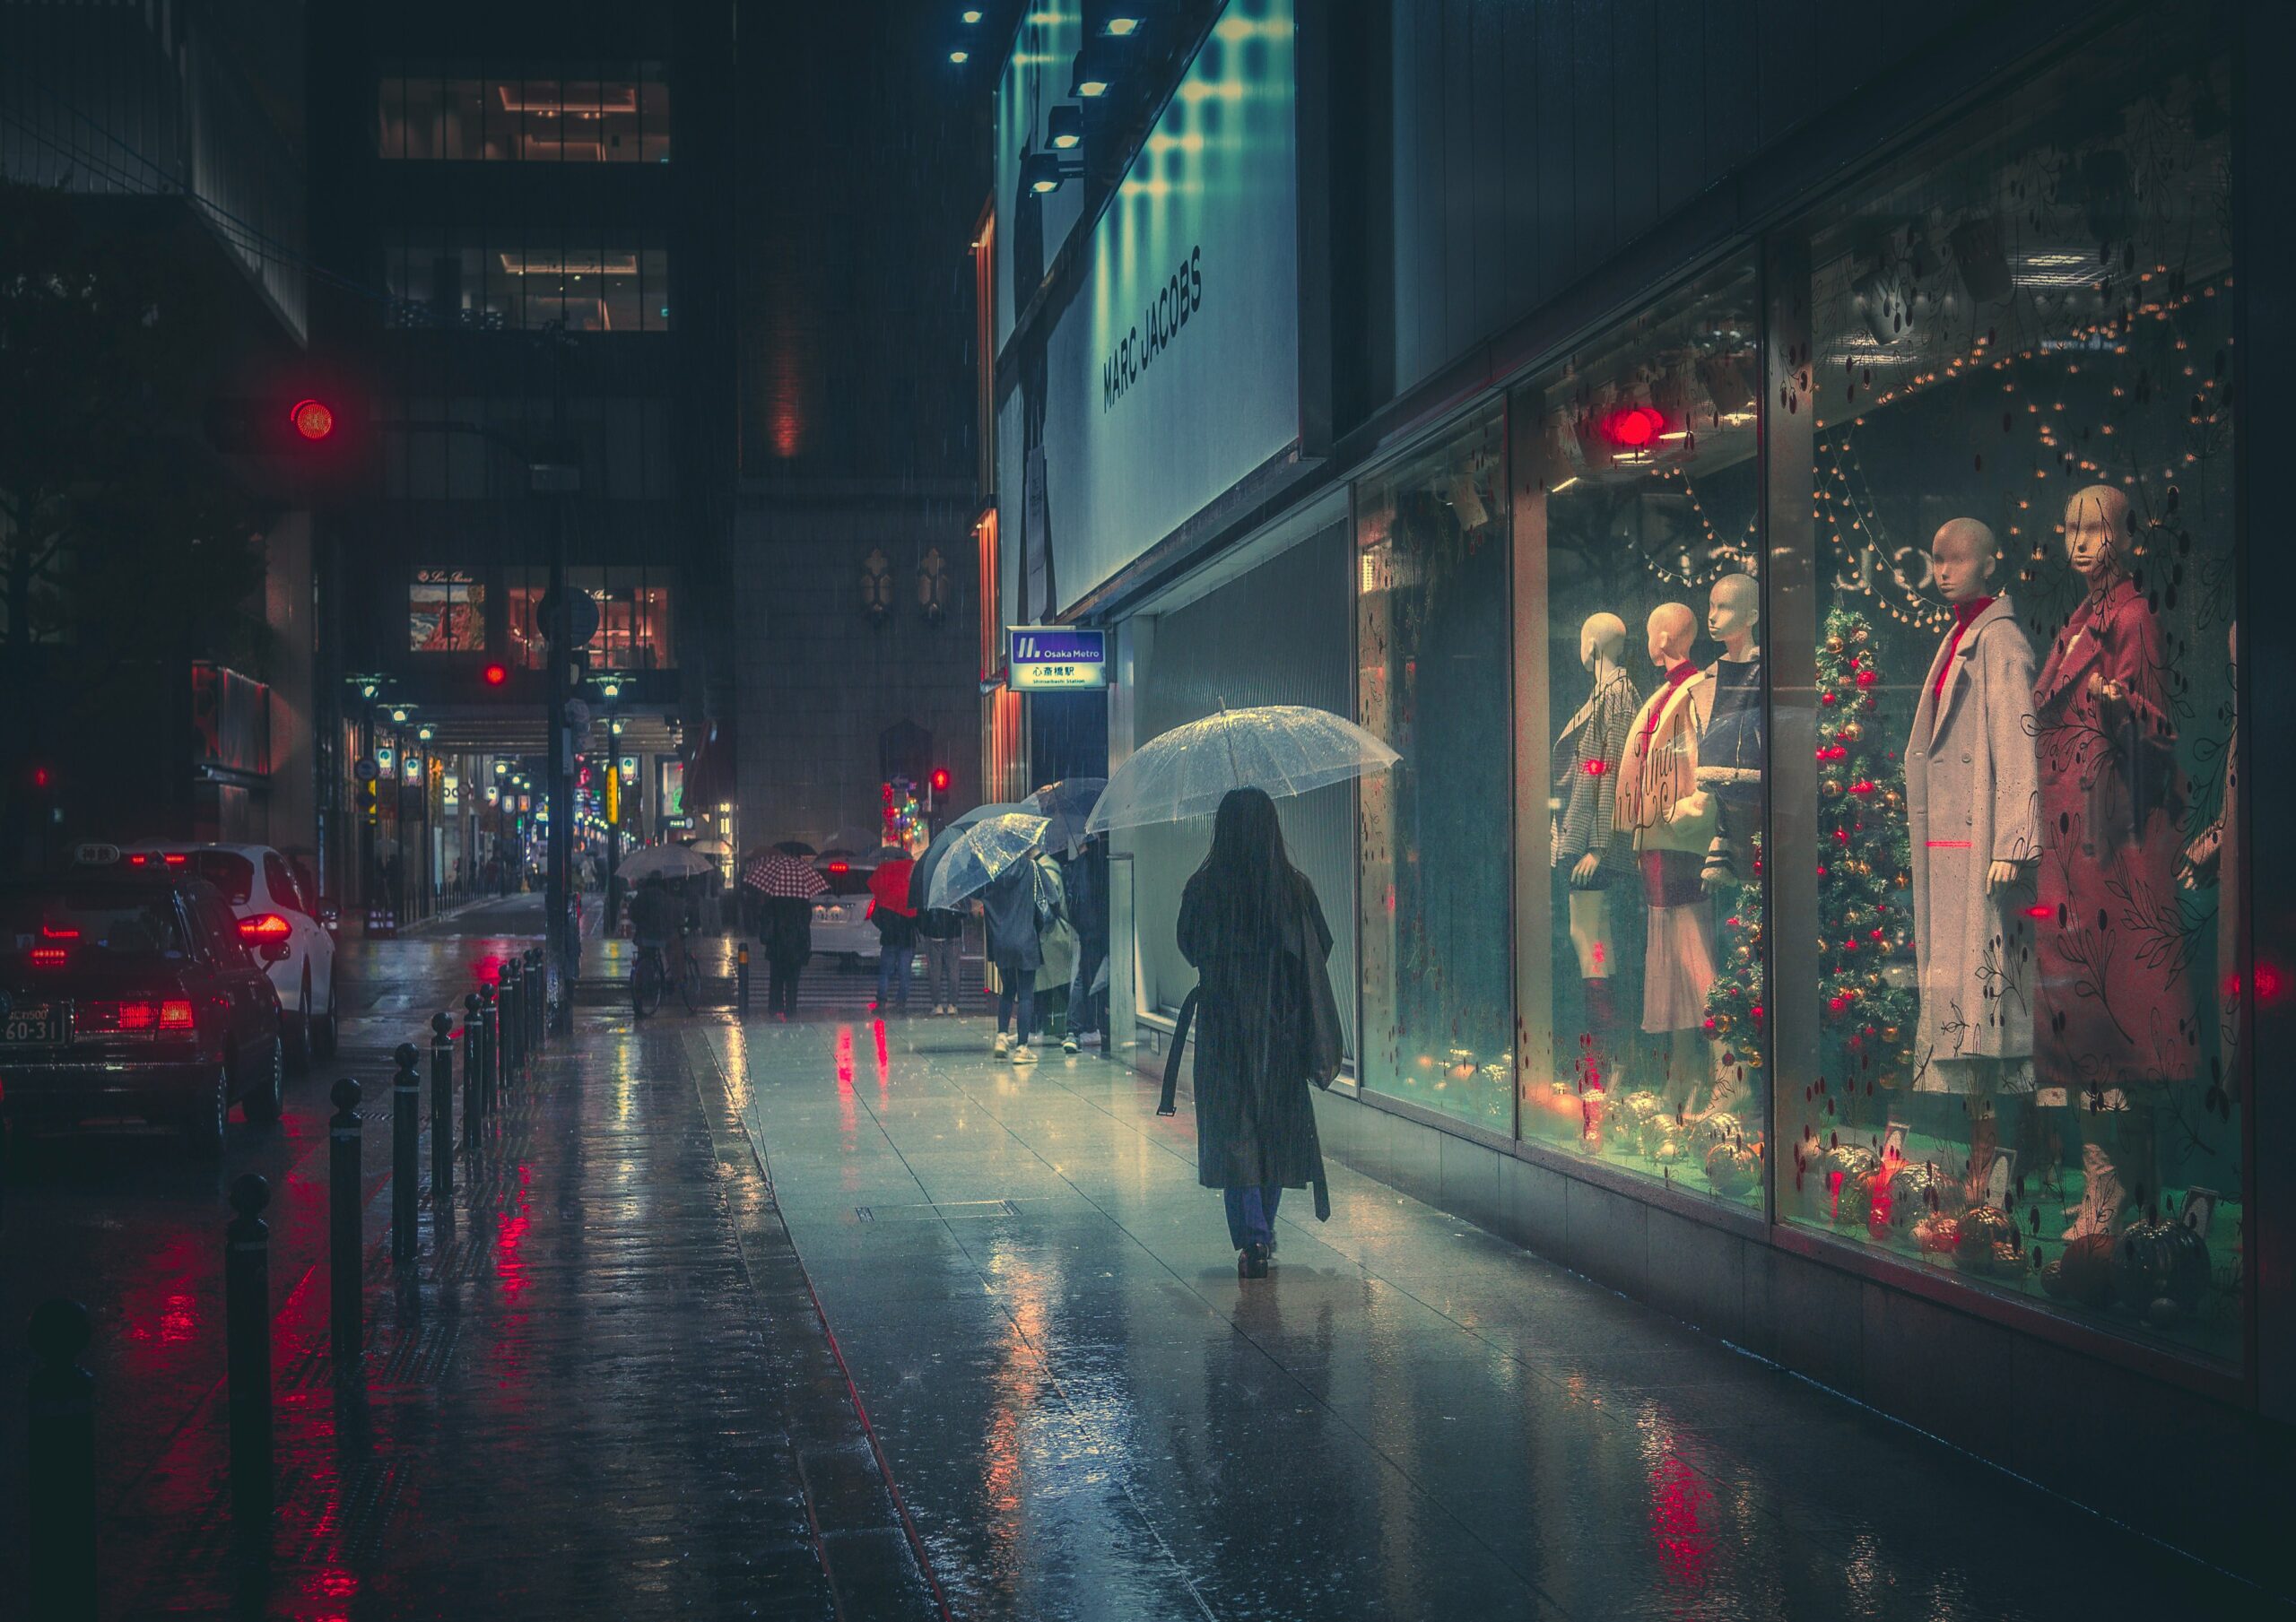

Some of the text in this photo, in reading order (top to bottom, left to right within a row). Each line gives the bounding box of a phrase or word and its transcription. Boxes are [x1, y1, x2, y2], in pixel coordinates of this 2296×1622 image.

[1103, 245, 1202, 414] MARC JACOBS
[1044, 650, 1100, 658] Osaka Metro
[1032, 666, 1074, 676] 心斎橋駅
[5, 1021, 56, 1040] 60-31
